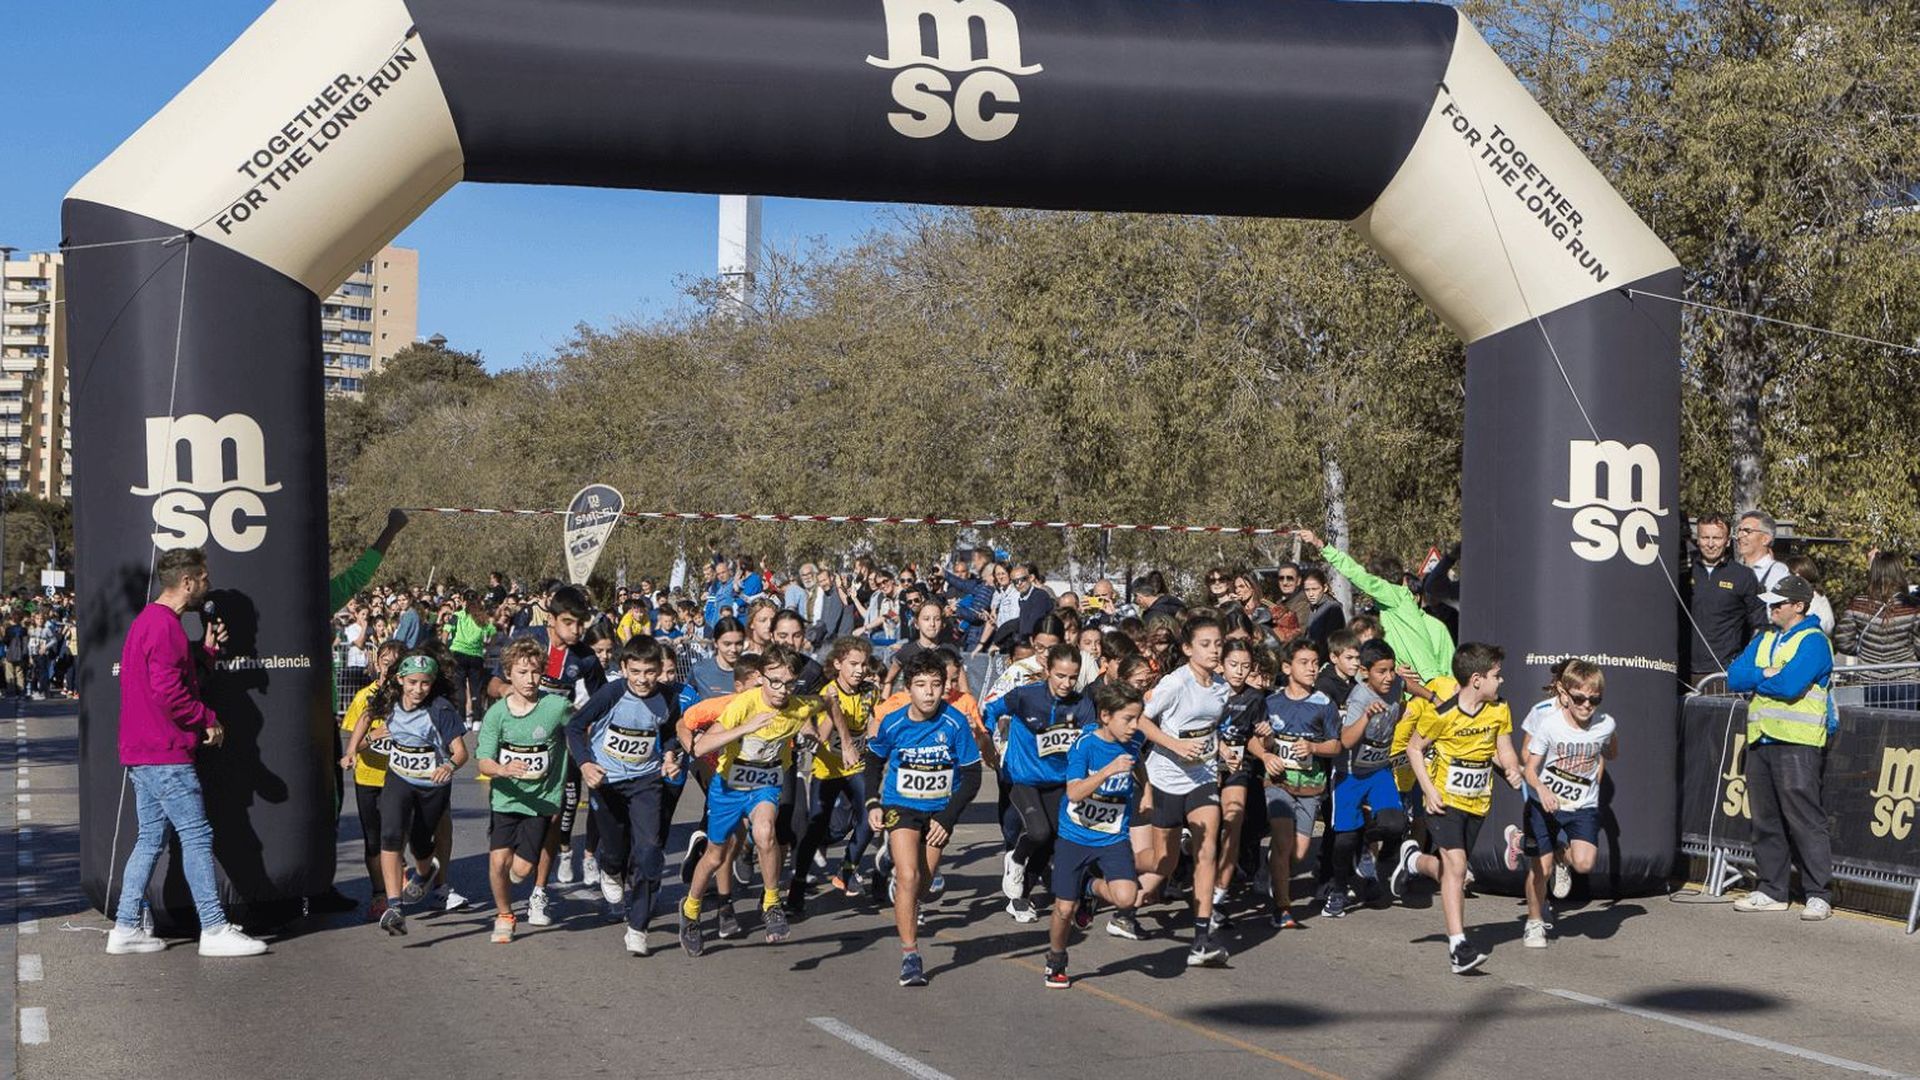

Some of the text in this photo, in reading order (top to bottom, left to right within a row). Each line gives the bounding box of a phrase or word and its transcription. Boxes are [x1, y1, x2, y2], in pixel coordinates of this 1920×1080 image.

[237, 73, 365, 180] TOGETHER,
[216, 46, 418, 235] FOR THE LONG RUN
[1488, 124, 1584, 236] TOGETHER,
[1441, 103, 1610, 283] FOR THE LONG RUN
[372, 739, 392, 751] 20
[608, 735, 649, 756] 2023
[1281, 745, 1308, 761] 02
[393, 752, 430, 770] 2023
[504, 755, 544, 772] 223
[734, 768, 779, 786] 2023
[902, 773, 948, 791] 2023
[1451, 771, 1489, 789] 2023
[1543, 775, 1583, 802] 2023
[1072, 800, 1119, 824] 2023
